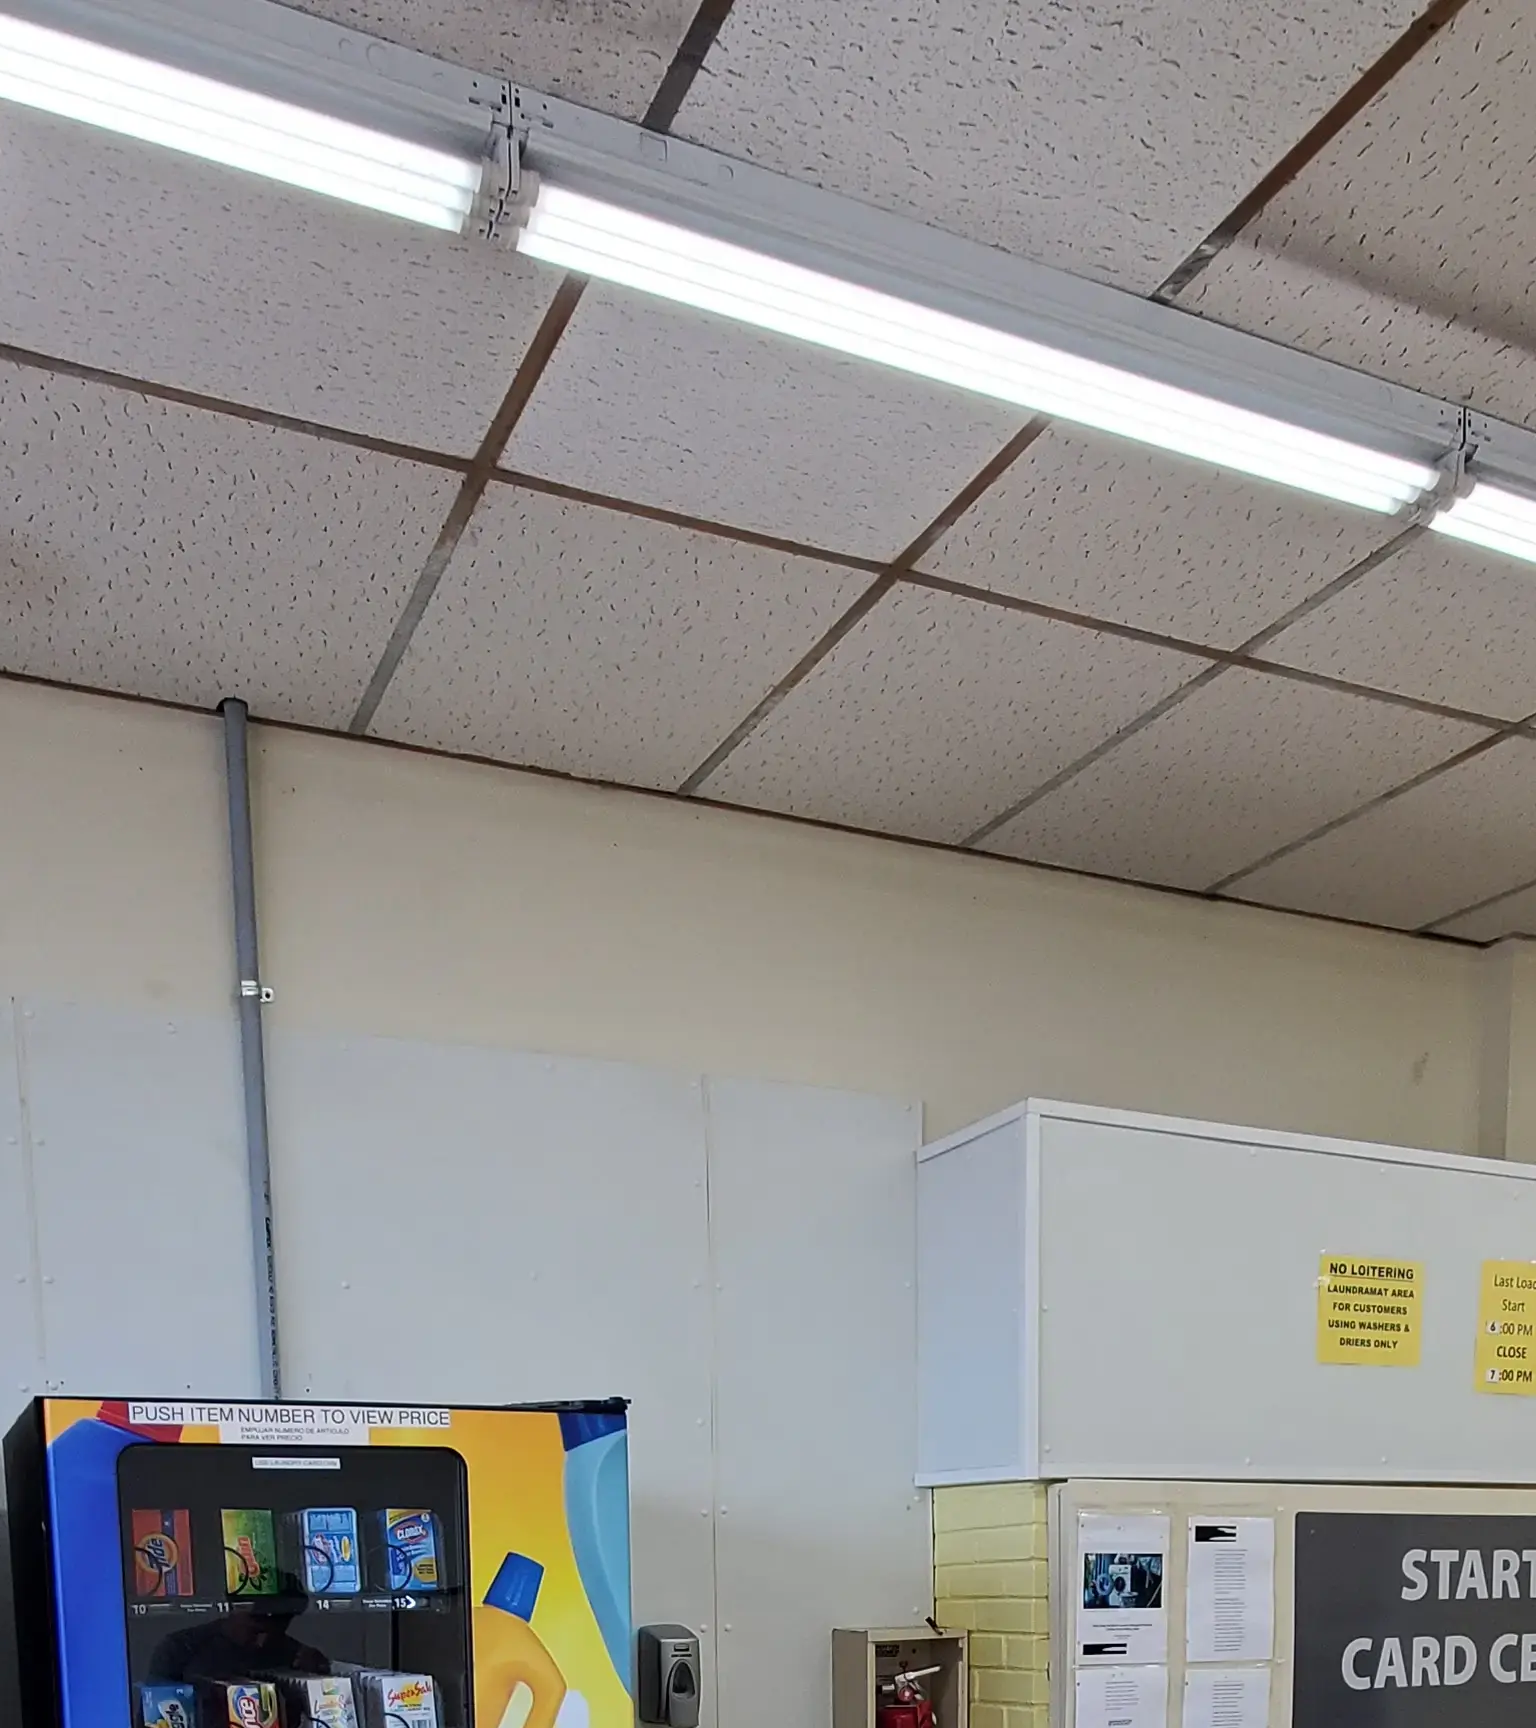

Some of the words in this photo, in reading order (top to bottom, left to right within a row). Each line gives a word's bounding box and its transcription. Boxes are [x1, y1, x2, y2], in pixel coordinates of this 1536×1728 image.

[1329, 1262, 1348, 1275] NO
[1351, 1263, 1415, 1280] LOITERING
[1493, 1274, 1514, 1289] Last
[1327, 1284, 1390, 1297] LAUNDRAMAT
[1391, 1288, 1415, 1299] AREA
[1332, 1301, 1352, 1312] FOR
[1353, 1303, 1408, 1316] CUSTOMERS
[1501, 1298, 1527, 1313] Start
[1327, 1318, 1356, 1330] USING
[1358, 1321, 1402, 1333] WASHERS
[1403, 1324, 1410, 1332] &
[1516, 1323, 1534, 1337] PM
[1339, 1336, 1372, 1348] DRIERS
[1373, 1339, 1399, 1350] ONLY
[1496, 1345, 1528, 1360] CLOSE
[1515, 1369, 1533, 1383] PM
[131, 1405, 185, 1422] PUSH
[190, 1406, 235, 1423] ITEM
[238, 1407, 315, 1424] NUMBER
[321, 1409, 345, 1424] TO
[349, 1409, 394, 1425] VIEW
[398, 1410, 450, 1426] PRICE
[132, 1604, 147, 1615] 10
[216, 1602, 230, 1613] 11
[316, 1600, 330, 1610] 14
[1340, 1635, 1478, 1692] CARD
